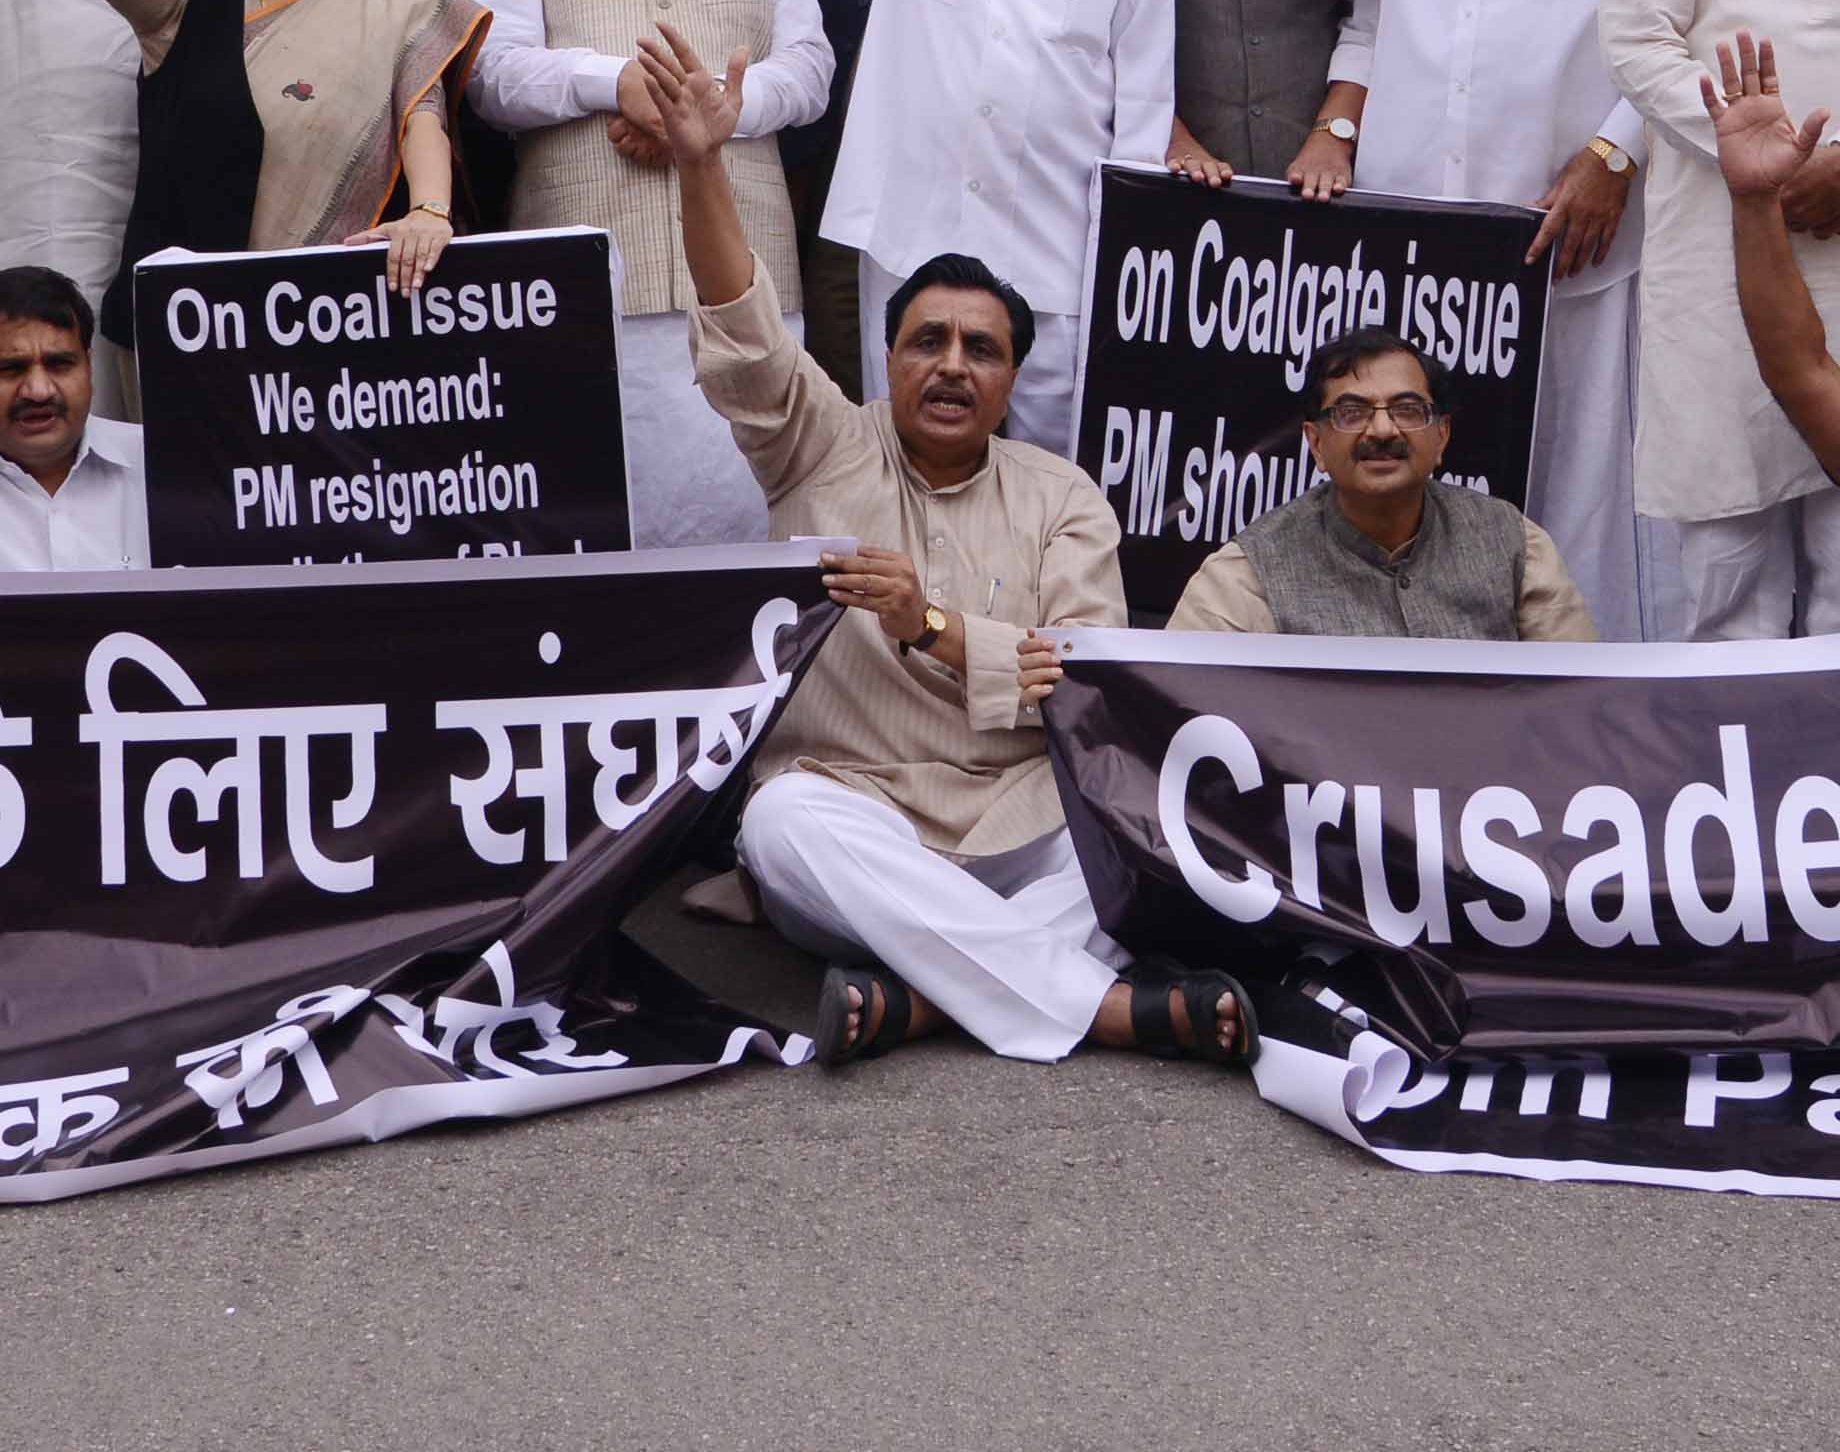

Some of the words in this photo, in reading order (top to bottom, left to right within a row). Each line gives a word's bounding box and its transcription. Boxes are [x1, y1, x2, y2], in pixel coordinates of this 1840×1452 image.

[166, 287, 247, 353] On
[264, 274, 391, 346] Coal
[1116, 245, 1175, 344] on
[1188, 218, 1386, 393] Coalgate
[1399, 240, 1521, 379] issue
[249, 371, 315, 435] We
[327, 356, 504, 431] demand:
[233, 463, 297, 530] PM
[310, 449, 539, 536] resignation
[1100, 405, 1173, 537] PM
[80, 631, 387, 892] लिए
